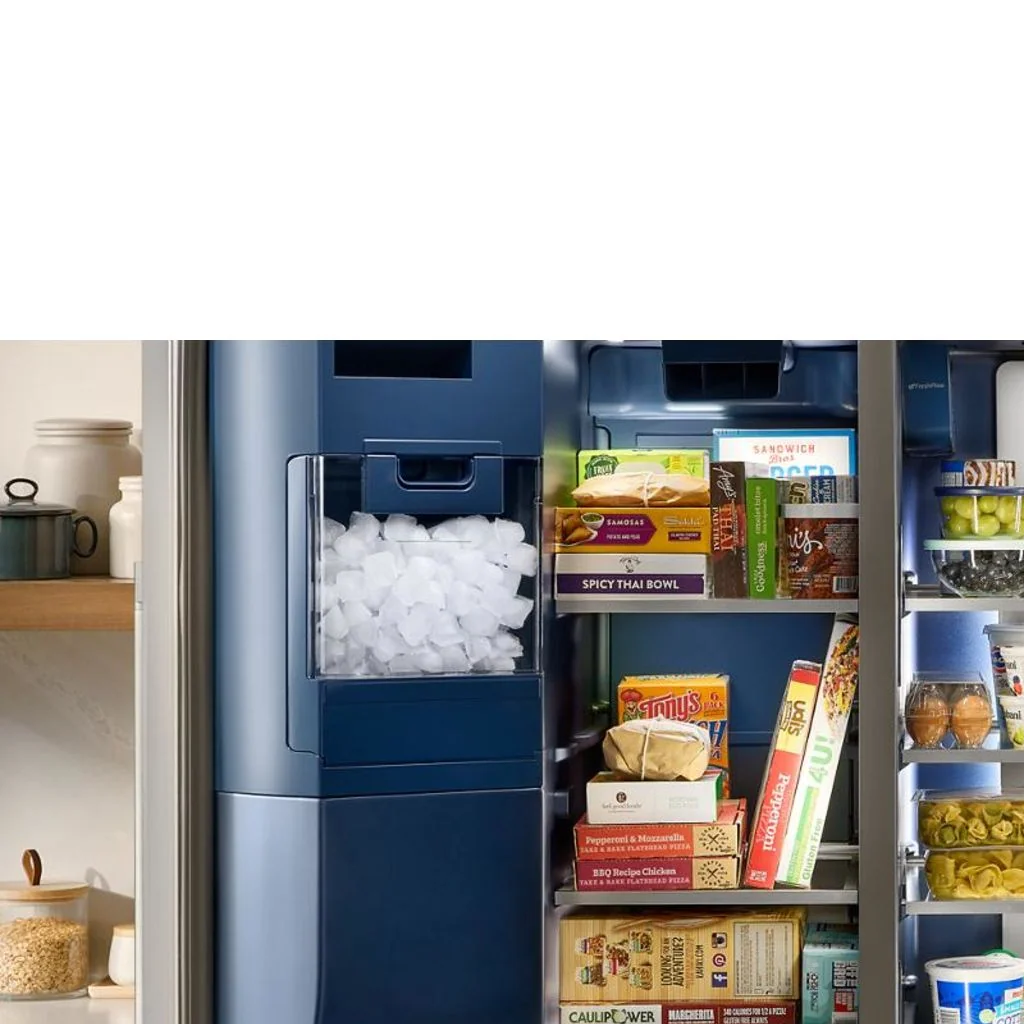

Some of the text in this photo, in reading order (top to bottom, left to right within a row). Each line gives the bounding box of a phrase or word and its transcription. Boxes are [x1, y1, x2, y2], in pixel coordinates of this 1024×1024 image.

[753, 444, 816, 454] SANDWICH
[606, 519, 645, 527] SAMOSAS
[719, 504, 734, 551] THAI
[754, 542, 768, 593] Goodness
[582, 579, 680, 590] SPICY THAI BOWL
[639, 688, 701, 722] Tony's
[762, 773, 791, 852] Pepperoni
[586, 833, 685, 846] Pepperoni & Mozzarella
[669, 843, 691, 851] PIZZA
[801, 844, 819, 881] Gluten
[612, 868, 641, 878] Recipe
[642, 867, 677, 876] Chicken
[668, 1008, 715, 1021] MARGHERITA
